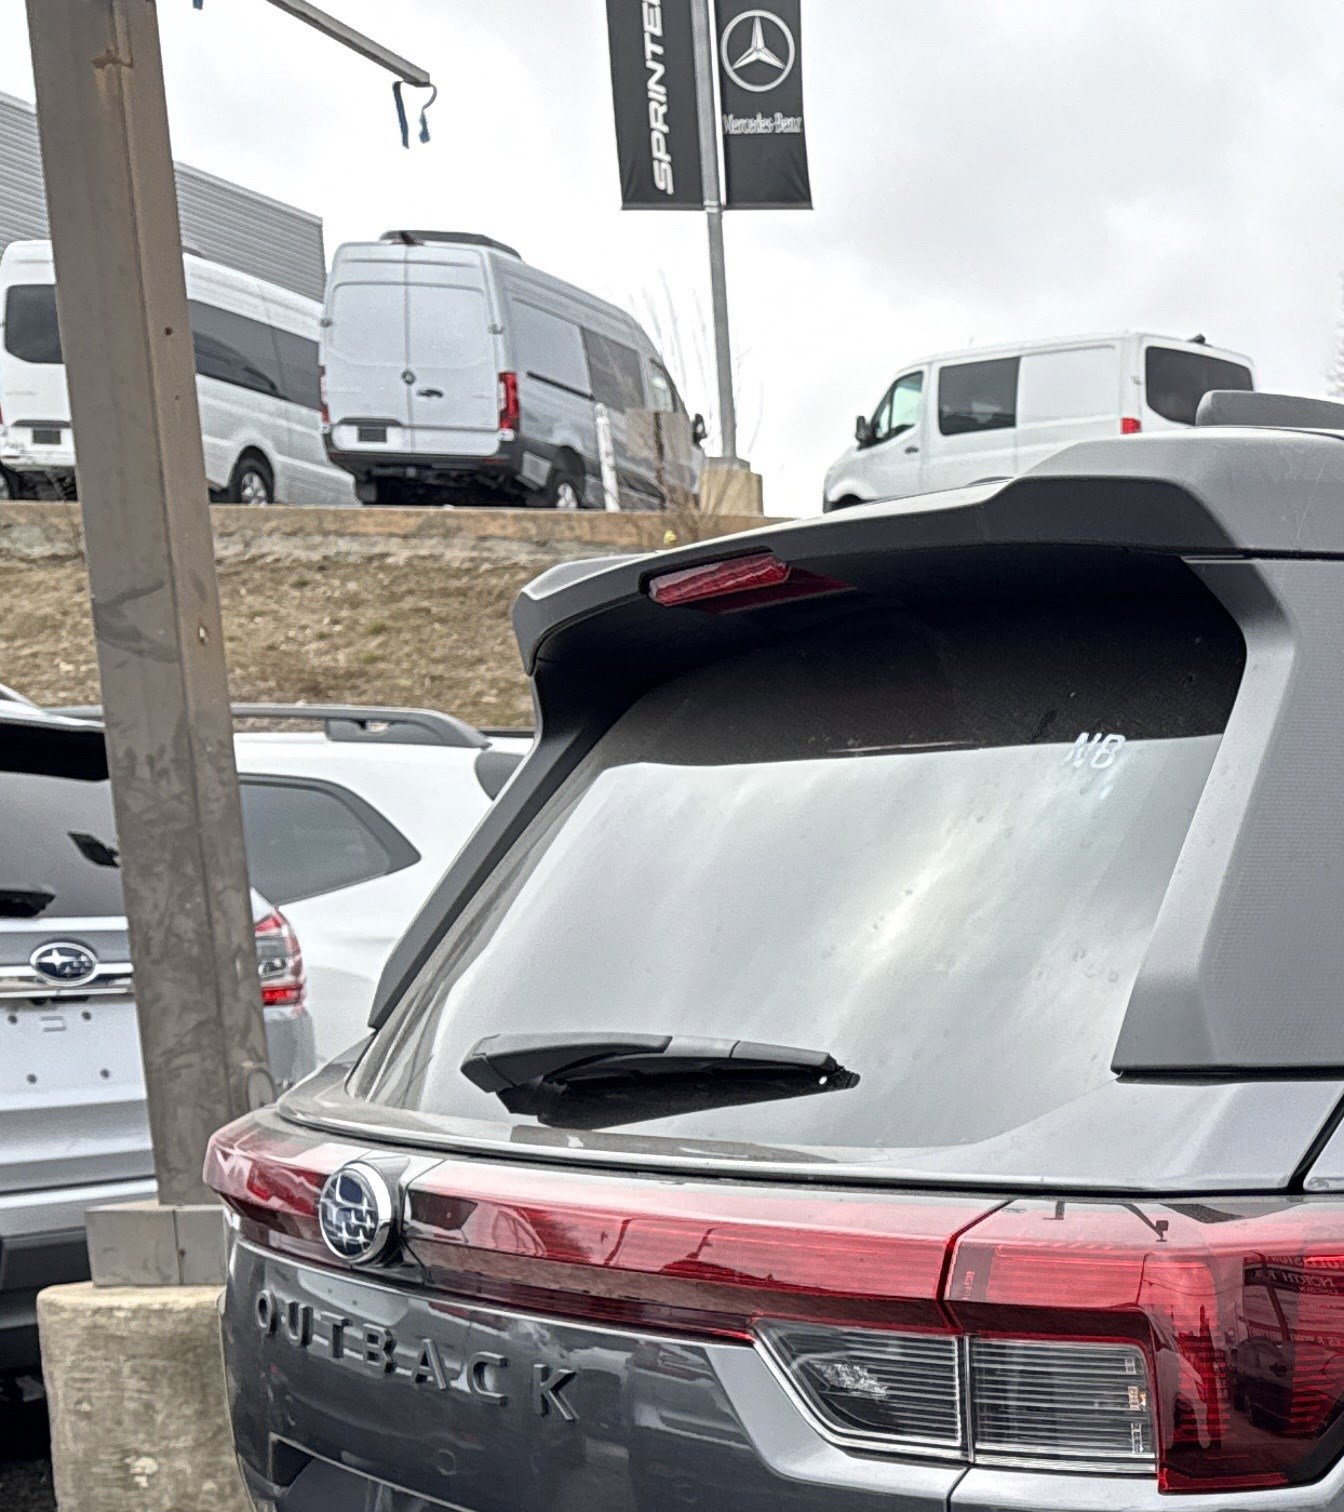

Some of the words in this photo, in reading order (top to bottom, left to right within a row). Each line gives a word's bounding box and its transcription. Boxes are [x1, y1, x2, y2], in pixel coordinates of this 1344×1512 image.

[642, 0, 674, 194] SPRINTE
[723, 112, 803, 134] Mercedes-Benz
[255, 1288, 580, 1422] OUTBACK
